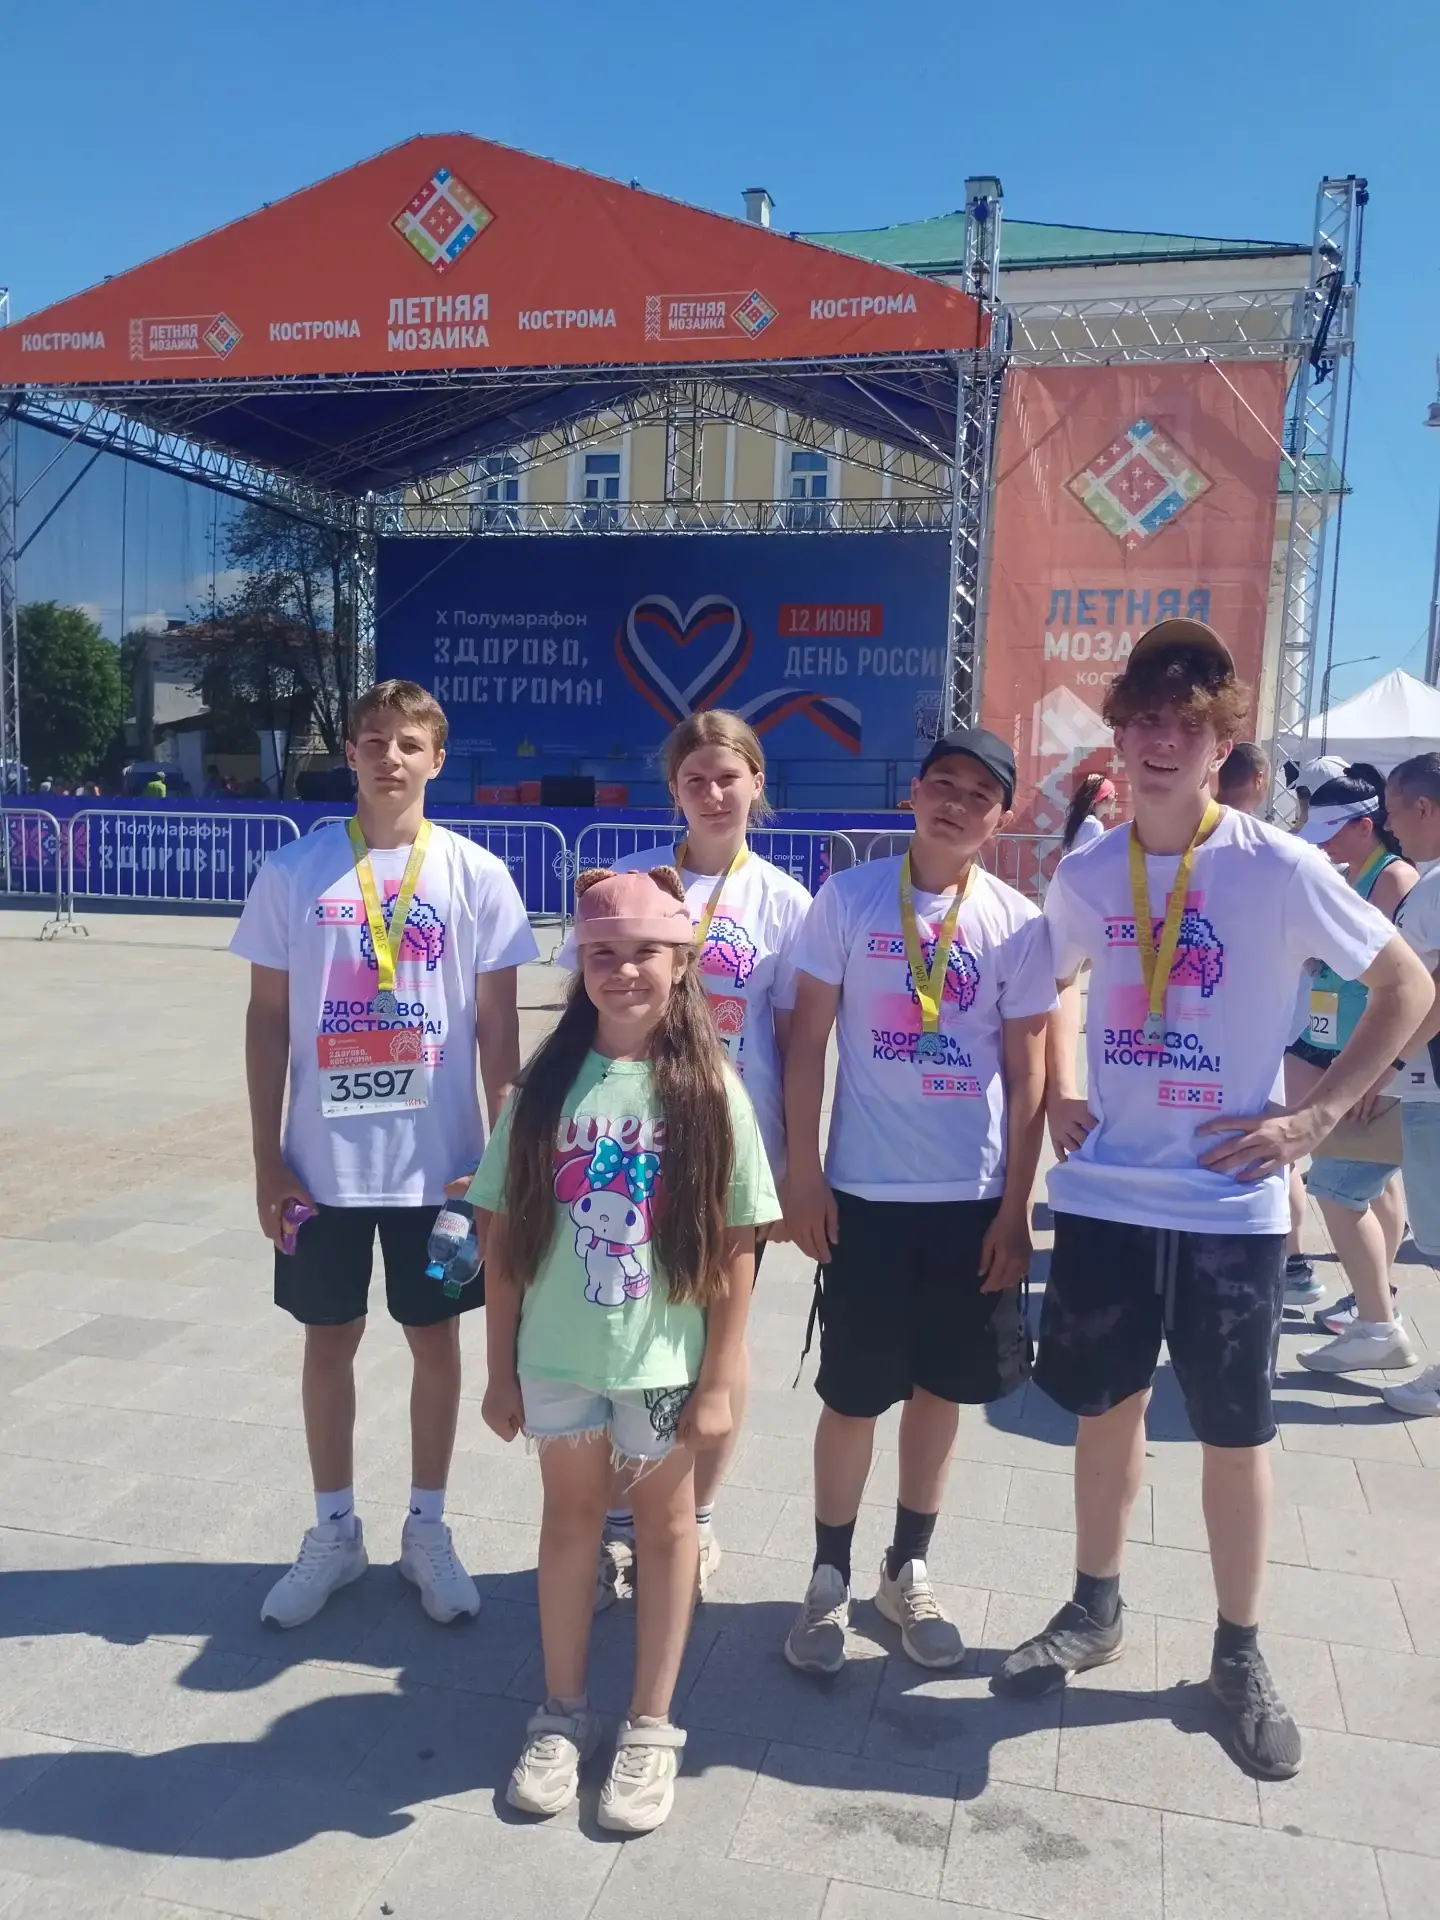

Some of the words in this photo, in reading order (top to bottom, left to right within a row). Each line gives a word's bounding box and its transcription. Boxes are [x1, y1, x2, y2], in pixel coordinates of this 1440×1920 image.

[387, 293, 489, 326] ЛЕТНЯЯ
[518, 308, 617, 330] КОСТРОМА
[668, 301, 726, 318] ЛЕТНЯЯ
[810, 293, 917, 320] КОСТРОМА
[149, 323, 198, 340] ЛЕТНЯЯ
[269, 319, 361, 341] КОСТРОМА
[668, 316, 726, 331] МОЗАИКА
[21, 331, 105, 352] КОСТРОМА
[149, 337, 198, 352] МОЗАИКА
[387, 325, 489, 352] МОЗАИКА
[453, 610, 587, 629] Полумарафон
[788, 609, 810, 633] 12
[815, 608, 871, 633] ИЮНЯ
[1044, 588, 1212, 627] ЛЕТНЯЯ
[433, 637, 589, 668] ЗДОРОВО,
[1044, 630, 1147, 662] МОЗА
[784, 646, 848, 678] ДЕНЬ
[433, 675, 603, 705] КОСТРОМА!
[115, 820, 232, 839] Полумарафон
[98, 845, 235, 874] ЗДОРОВО,
[322, 1001, 429, 1020] ЗДОРВО,
[329, 1068, 415, 1102] 3597
[556, 1114, 668, 1153] wee
